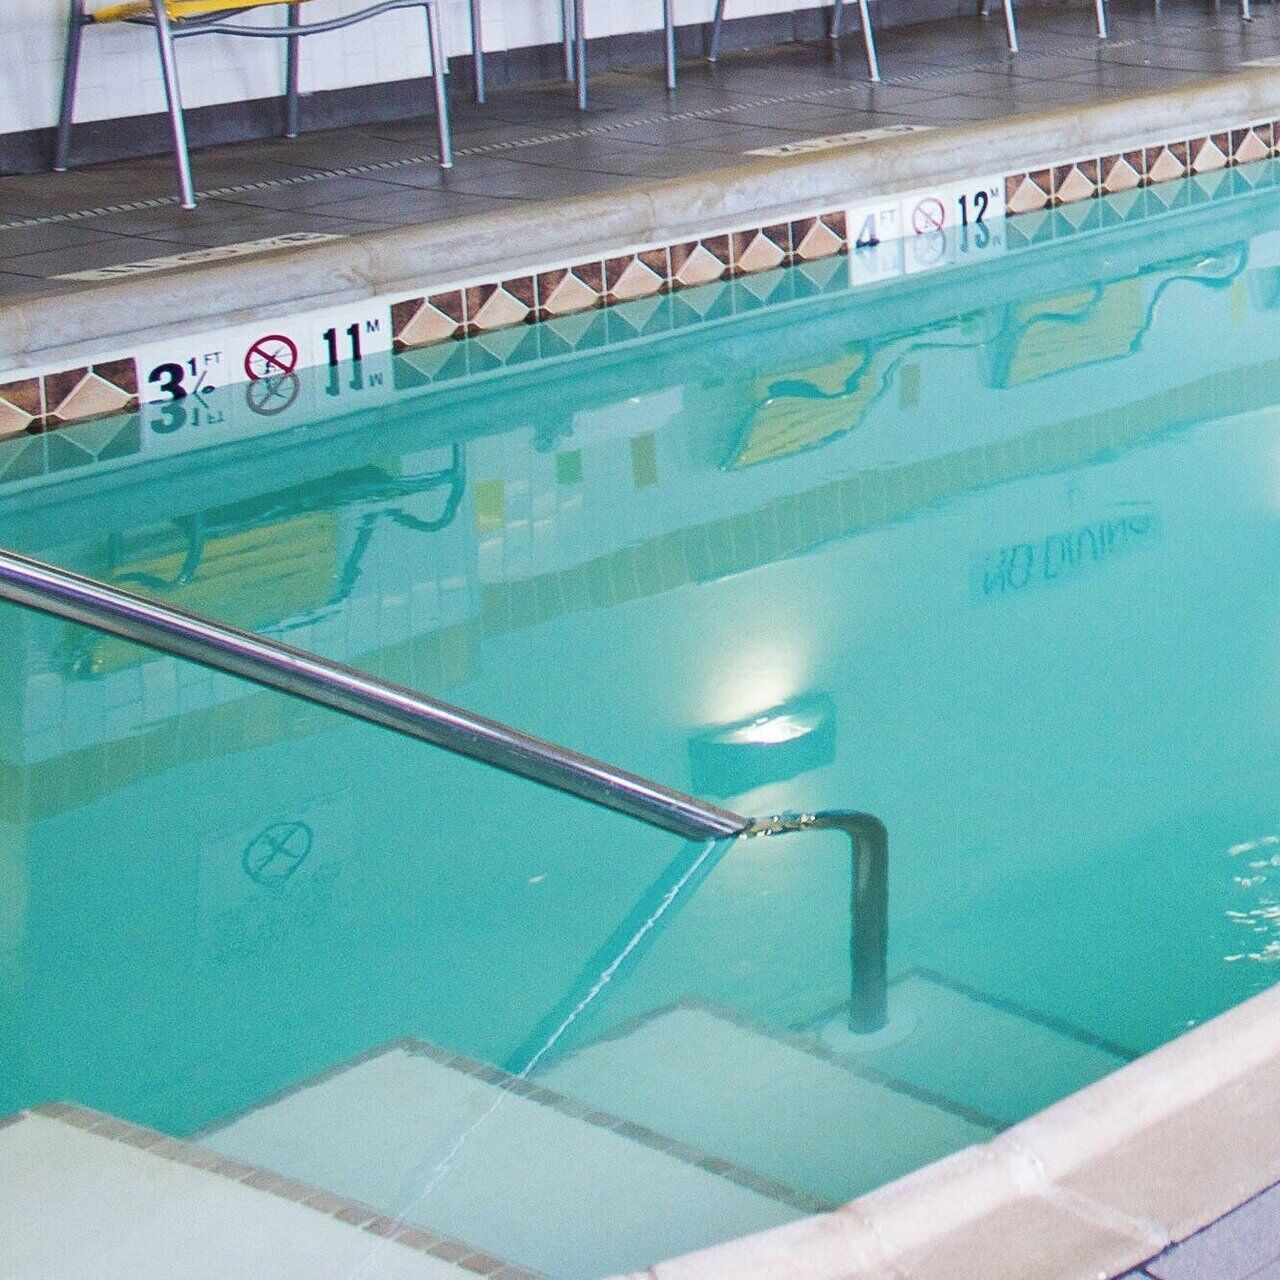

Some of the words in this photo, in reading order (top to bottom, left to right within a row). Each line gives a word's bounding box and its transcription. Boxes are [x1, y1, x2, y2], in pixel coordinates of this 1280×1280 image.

[856, 213, 879, 248] 4
[880, 210, 895, 226] FT
[366, 319, 381, 333] M
[148, 362, 187, 404] 3
[204, 351, 222, 365] FT
